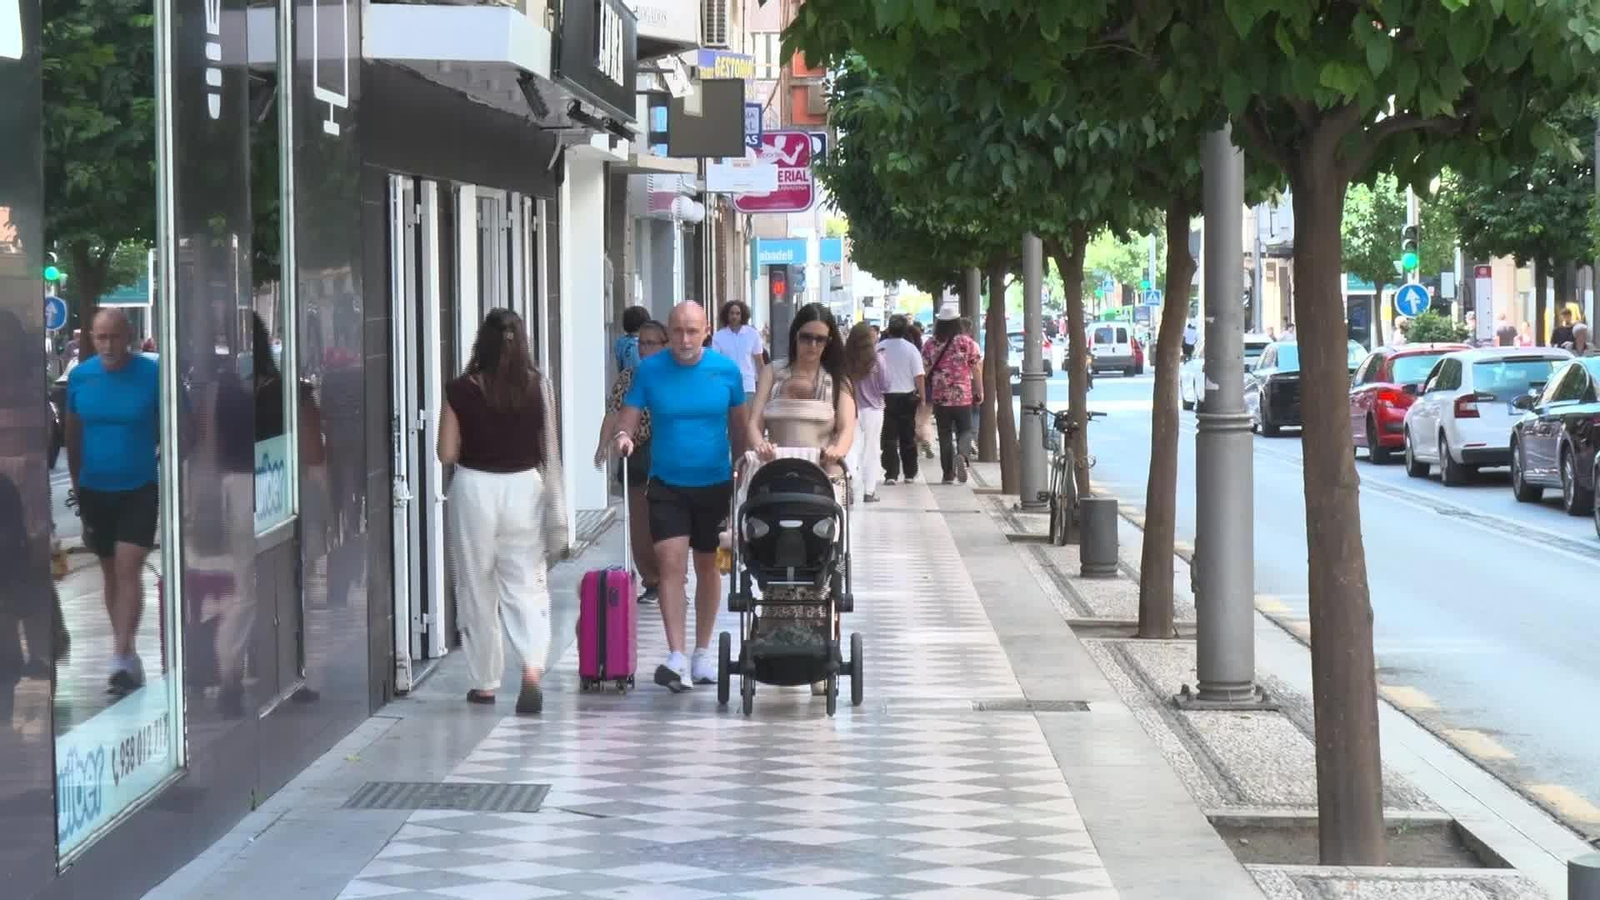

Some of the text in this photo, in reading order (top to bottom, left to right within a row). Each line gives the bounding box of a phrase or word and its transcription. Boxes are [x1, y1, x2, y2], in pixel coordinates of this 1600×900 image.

[778, 170, 809, 182] ERIAL
[120, 735, 135, 778] 958
[137, 724, 152, 767] 012
